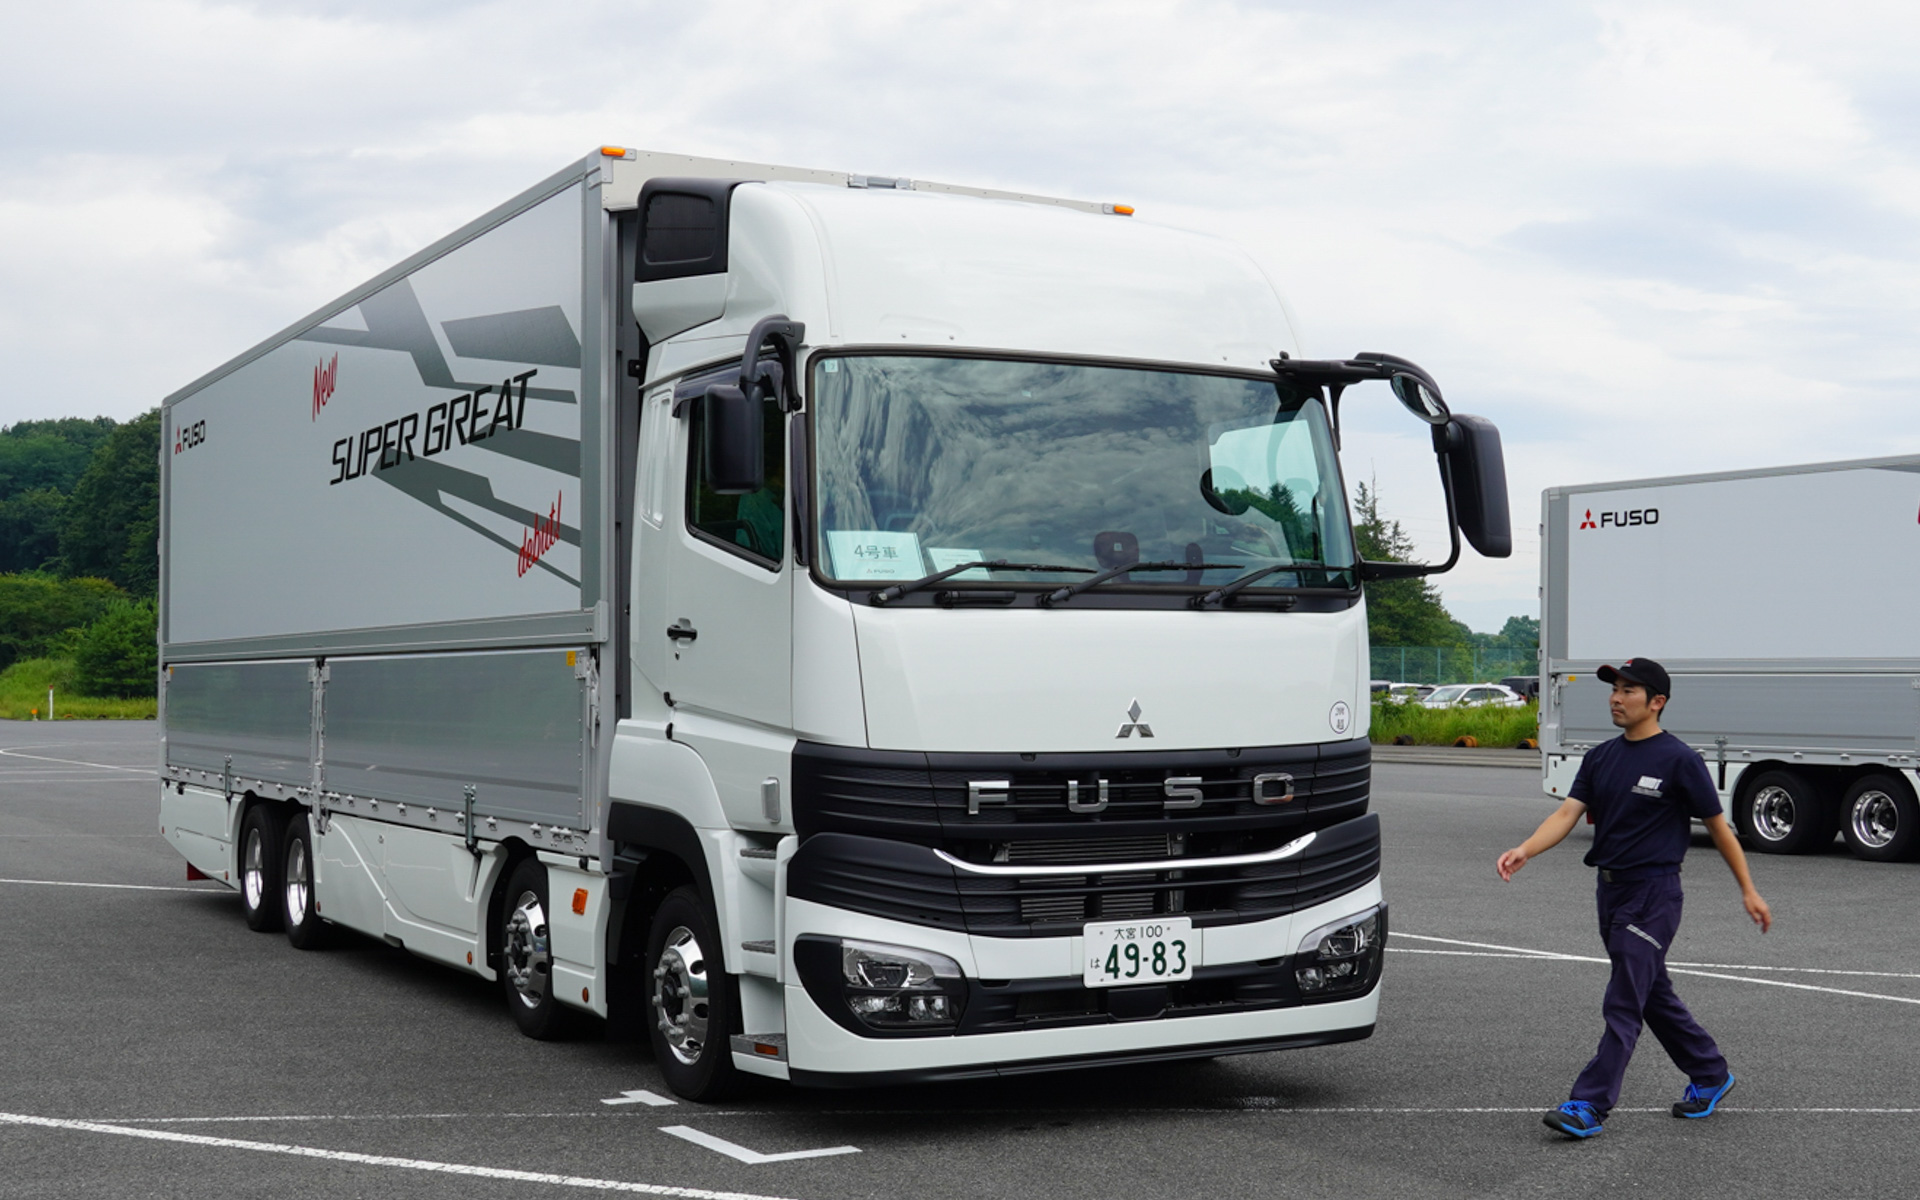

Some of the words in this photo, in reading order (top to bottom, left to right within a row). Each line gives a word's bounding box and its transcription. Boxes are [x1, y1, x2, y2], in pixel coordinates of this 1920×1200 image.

[312, 352, 338, 422] New
[182, 419, 206, 451] FUSO
[330, 412, 419, 485] SUPER
[422, 369, 538, 457] GREAT
[517, 490, 562, 578] debut!
[1600, 508, 1660, 528] FUSO
[854, 544, 899, 559] 4号車
[967, 772, 1296, 815] FUSO
[1090, 957, 1101, 970] は
[1104, 939, 1187, 980] 49-83
